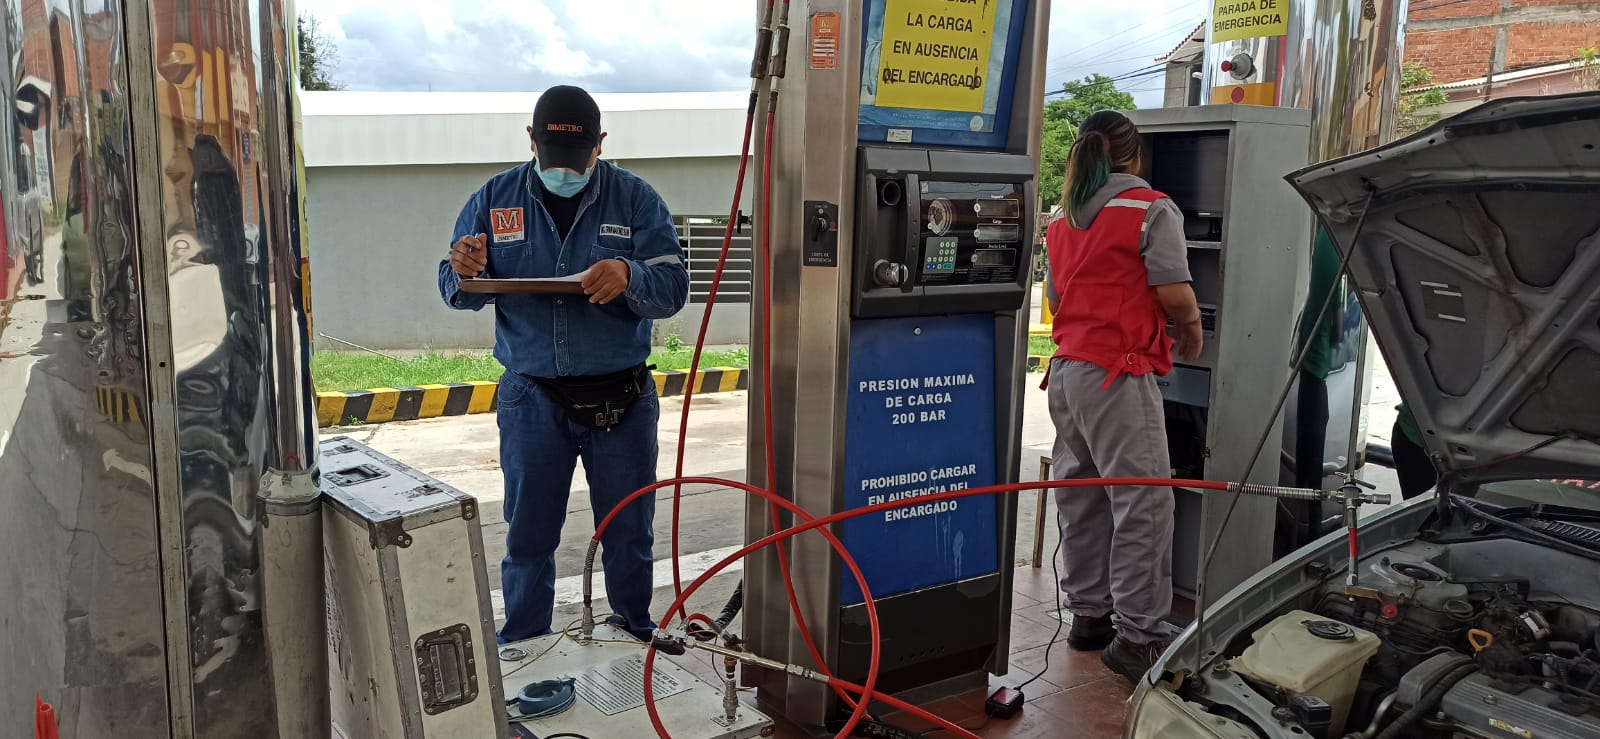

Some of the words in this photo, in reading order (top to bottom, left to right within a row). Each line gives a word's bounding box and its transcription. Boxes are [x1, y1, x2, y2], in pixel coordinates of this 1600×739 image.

[1218, 2, 1256, 16] PARADA
[1260, 0, 1277, 9] DE
[906, 12, 924, 27] LA
[927, 15, 973, 33] CARGA
[1214, 14, 1282, 32] EMERGENCIA
[893, 40, 911, 54] EN
[914, 42, 979, 61] AUSENCIA
[882, 68, 906, 84] DEL
[908, 70, 982, 89] ENCARGADO
[496, 210, 520, 231] M
[859, 378, 919, 392] PRESION
[924, 373, 975, 388] MAXIMA
[885, 396, 903, 408] DE
[908, 393, 952, 406] CARGA
[892, 413, 915, 425] 200
[920, 410, 946, 422] BAR
[861, 471, 927, 491] PROHIBIDO
[930, 464, 976, 480] CARGAR
[868, 496, 885, 507] EN
[885, 500, 958, 522] ENCARGADO
